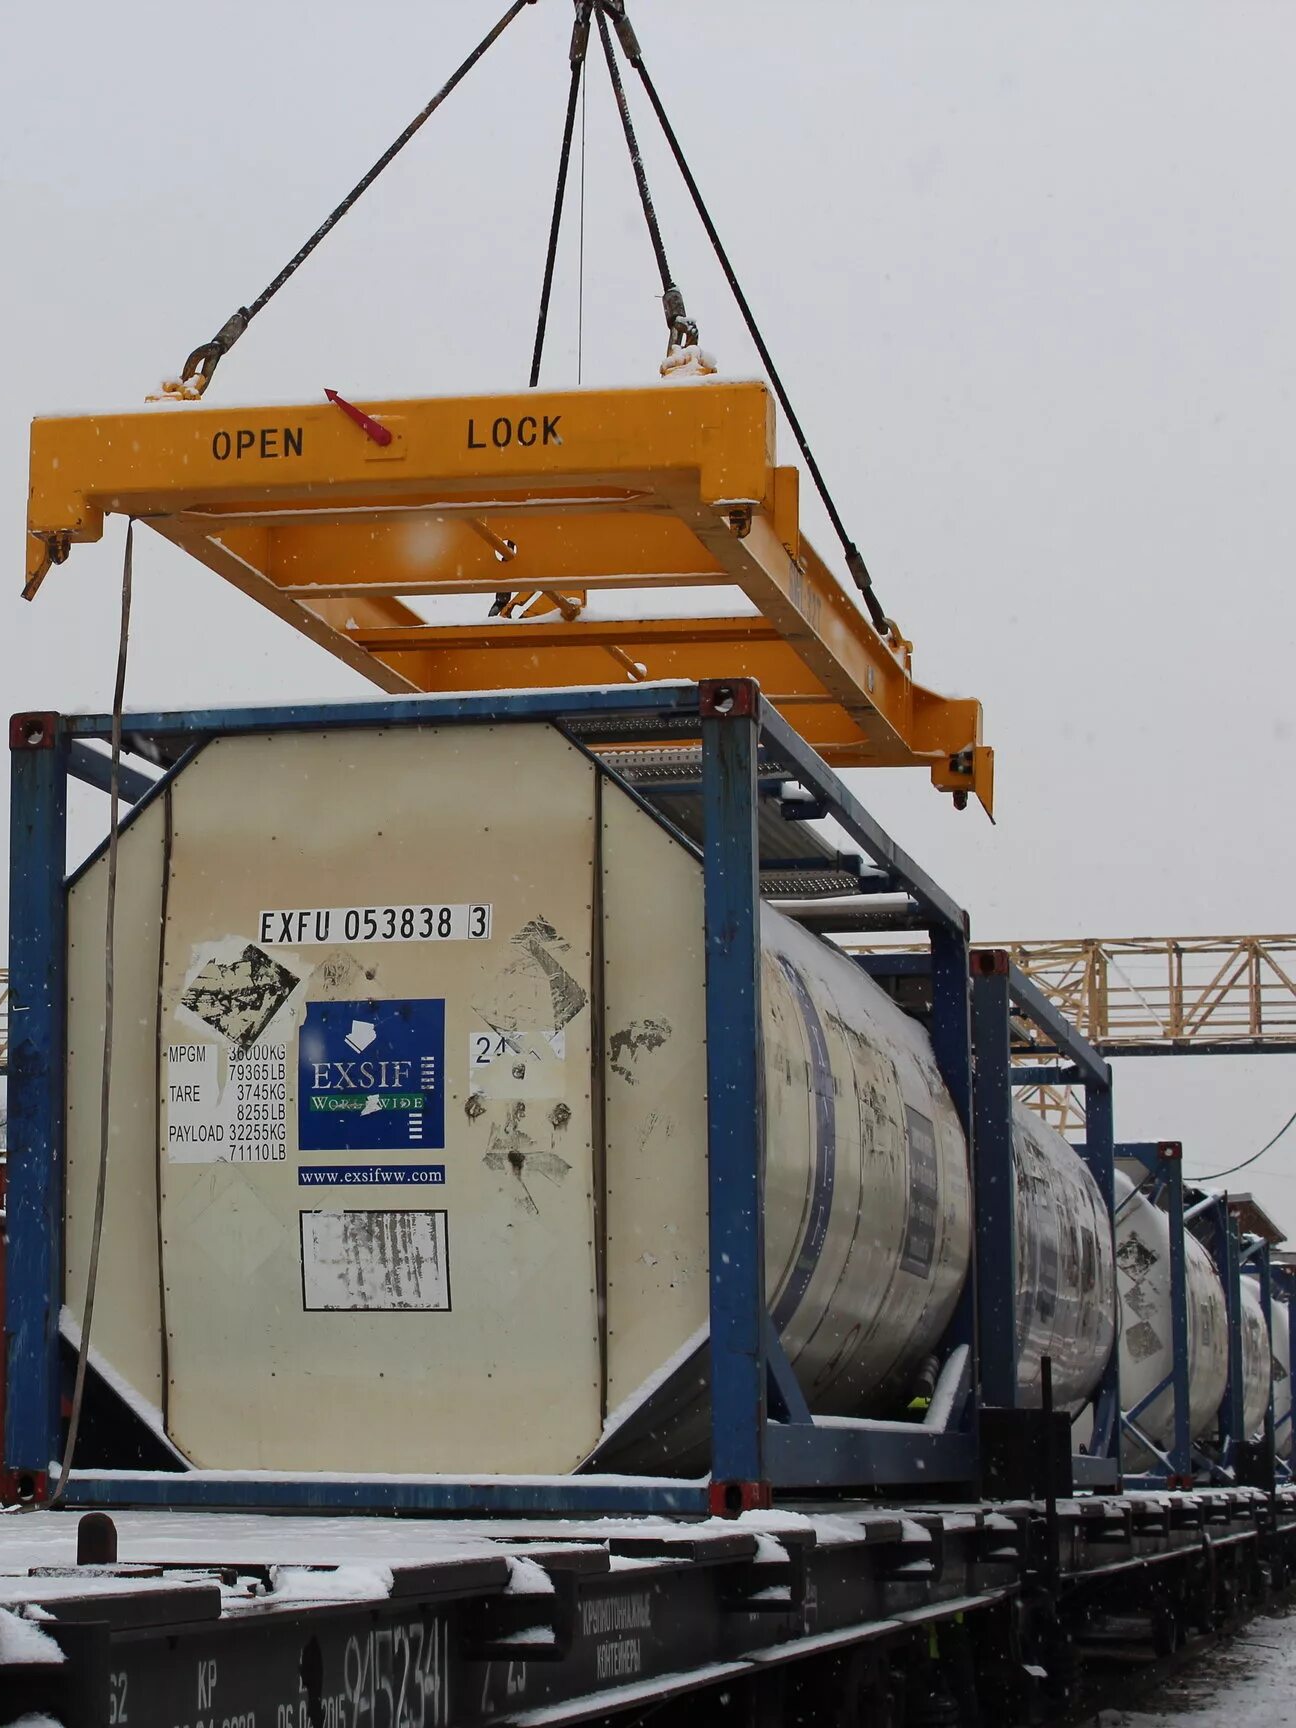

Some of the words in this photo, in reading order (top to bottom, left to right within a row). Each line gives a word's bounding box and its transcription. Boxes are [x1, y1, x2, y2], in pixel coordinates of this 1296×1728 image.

[212, 427, 304, 461] OPEN
[467, 415, 563, 449] LOCK
[260, 910, 331, 944] EXFU
[344, 907, 453, 941] 053838
[471, 906, 487, 938] 3
[168, 1045, 207, 1063] MPGM
[311, 1060, 413, 1090] EXSIF
[169, 1085, 201, 1102] TARE
[168, 1124, 225, 1142] PAYLOAD
[300, 1168, 443, 1183] www.exsifww.com
